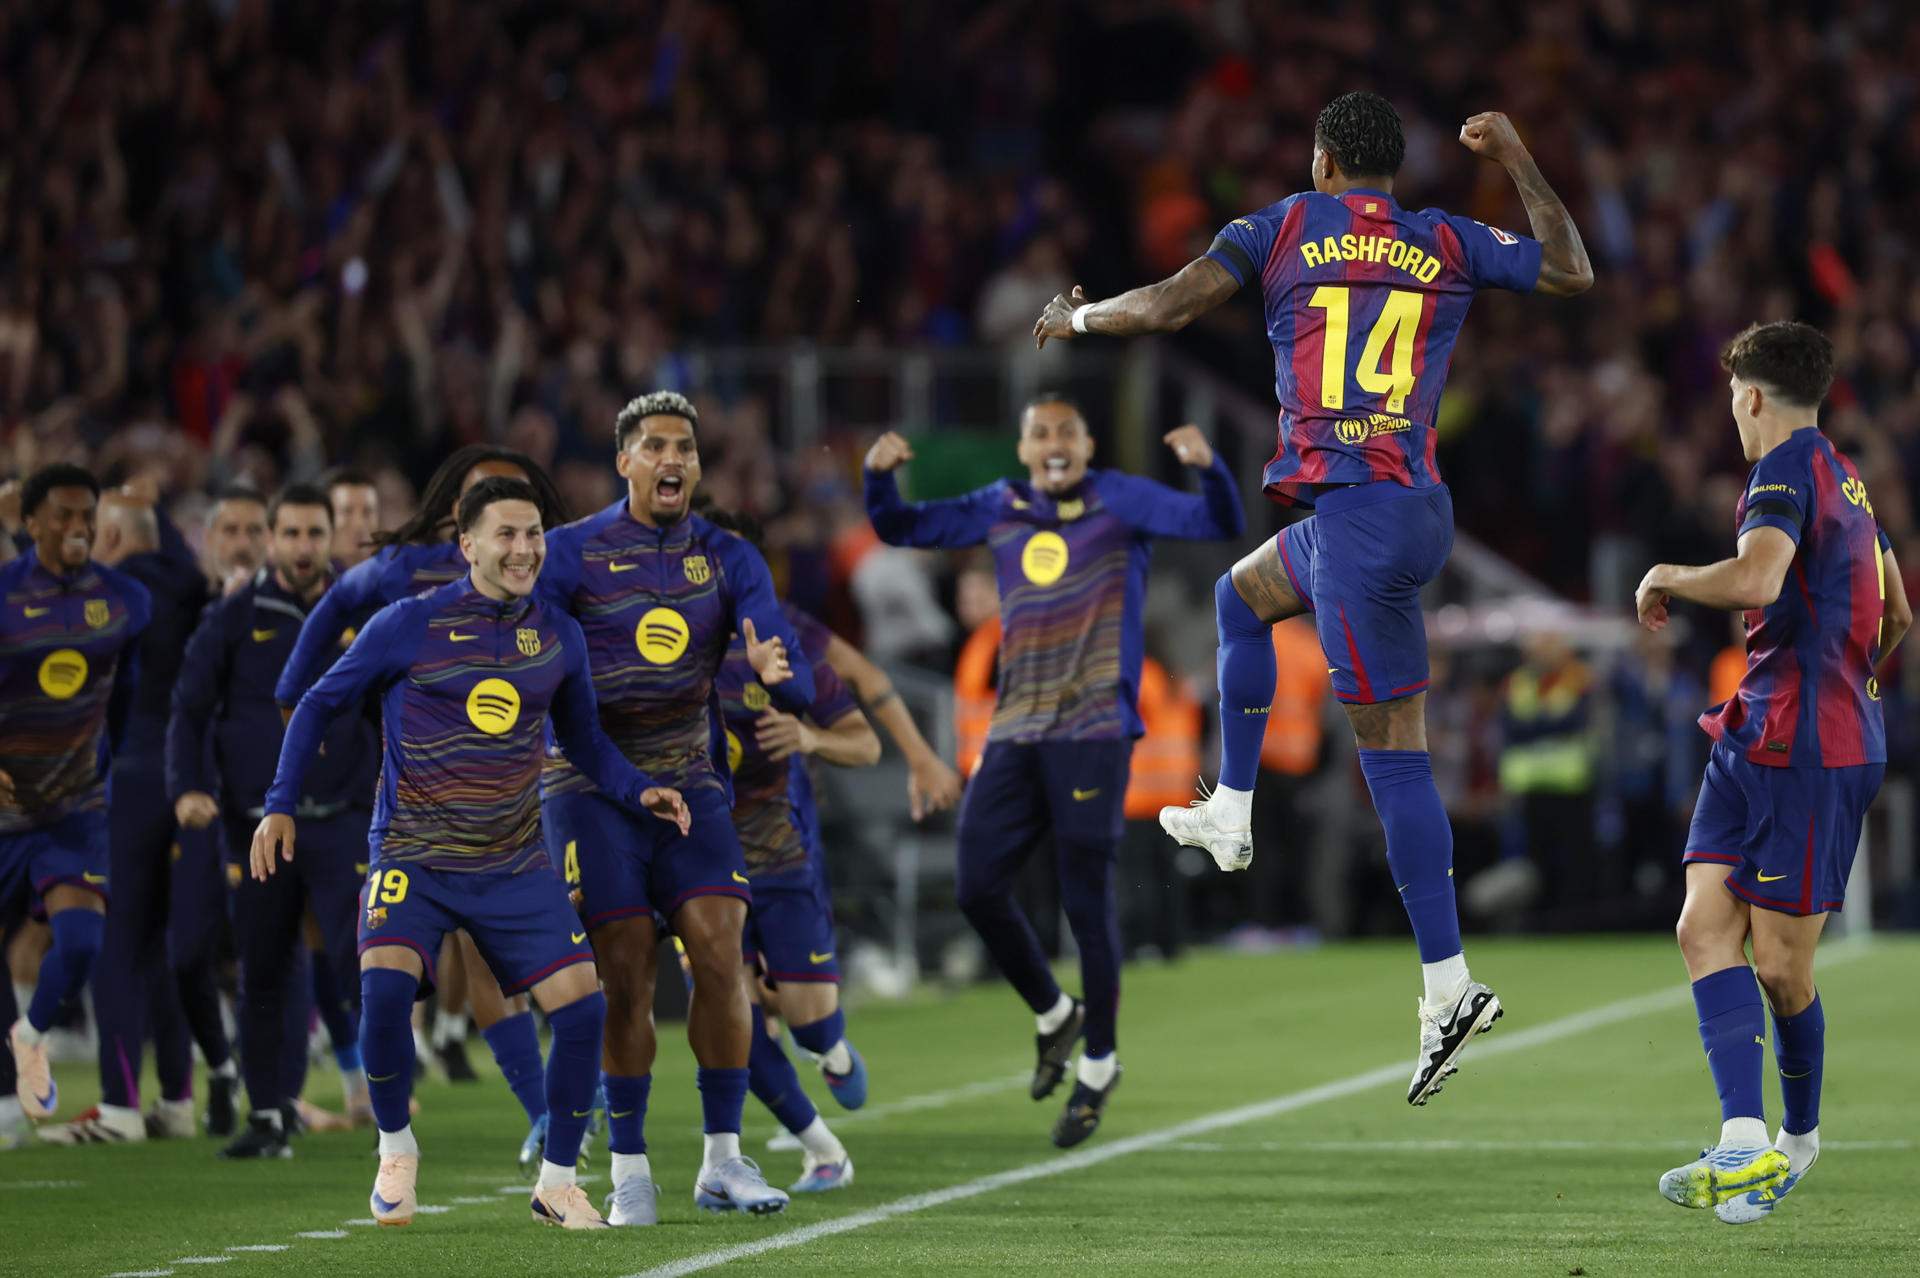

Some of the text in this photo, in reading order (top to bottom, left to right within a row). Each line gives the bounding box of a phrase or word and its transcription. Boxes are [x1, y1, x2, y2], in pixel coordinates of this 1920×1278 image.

[1300, 234, 1441, 284] RASHFORD
[1308, 286, 1423, 414] 14
[564, 839, 580, 884] 4
[367, 869, 409, 908] 19
